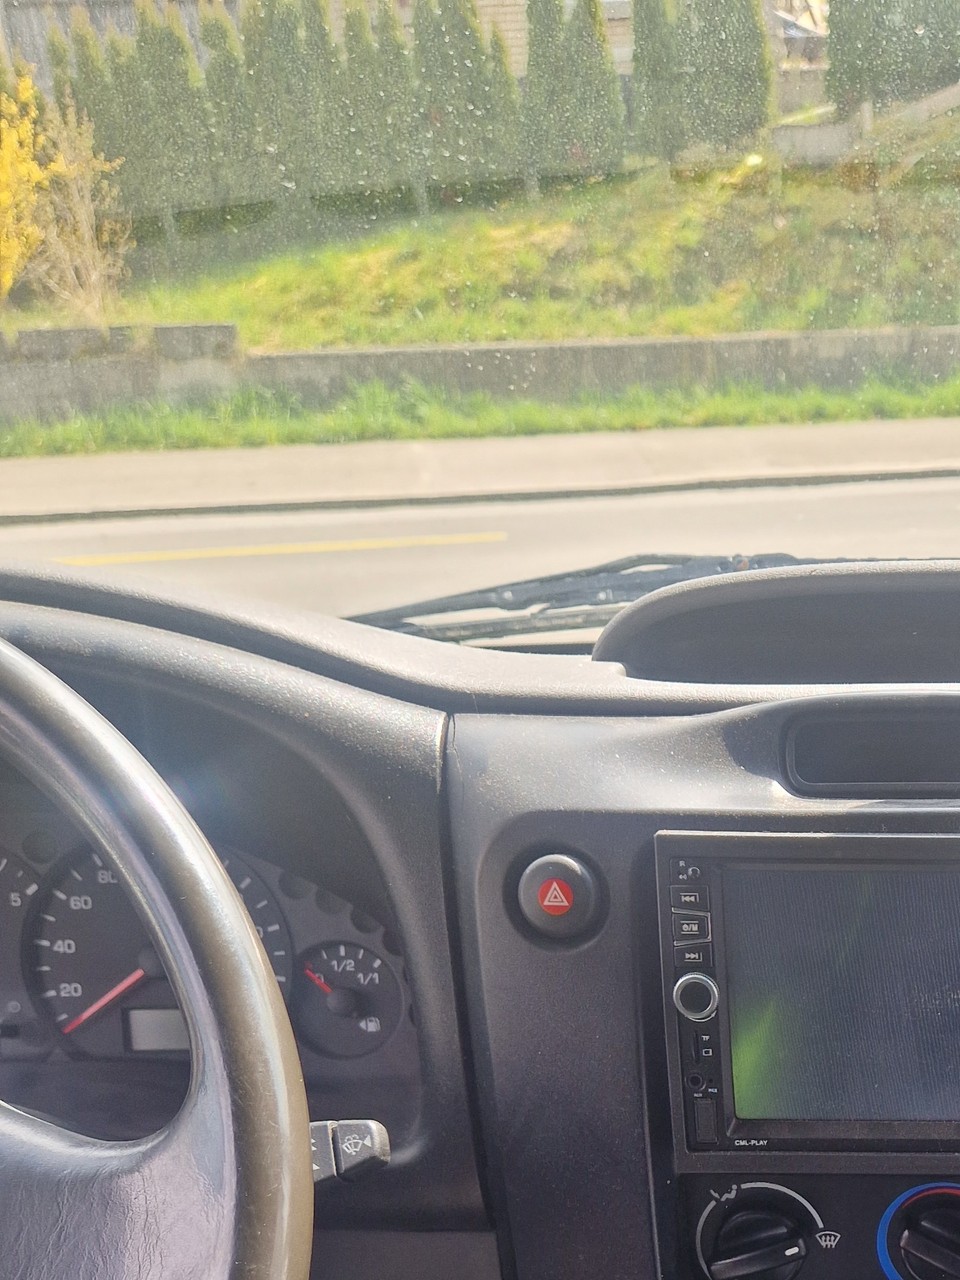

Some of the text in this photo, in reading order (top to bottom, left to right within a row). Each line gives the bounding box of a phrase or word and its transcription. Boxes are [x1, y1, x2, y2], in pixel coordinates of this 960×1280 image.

[10, 892, 22, 907] 5
[69, 896, 92, 910] 60
[53, 939, 76, 953] 40
[331, 959, 355, 972] 1/2
[357, 972, 379, 985] 1/1
[60, 983, 82, 997] 20
